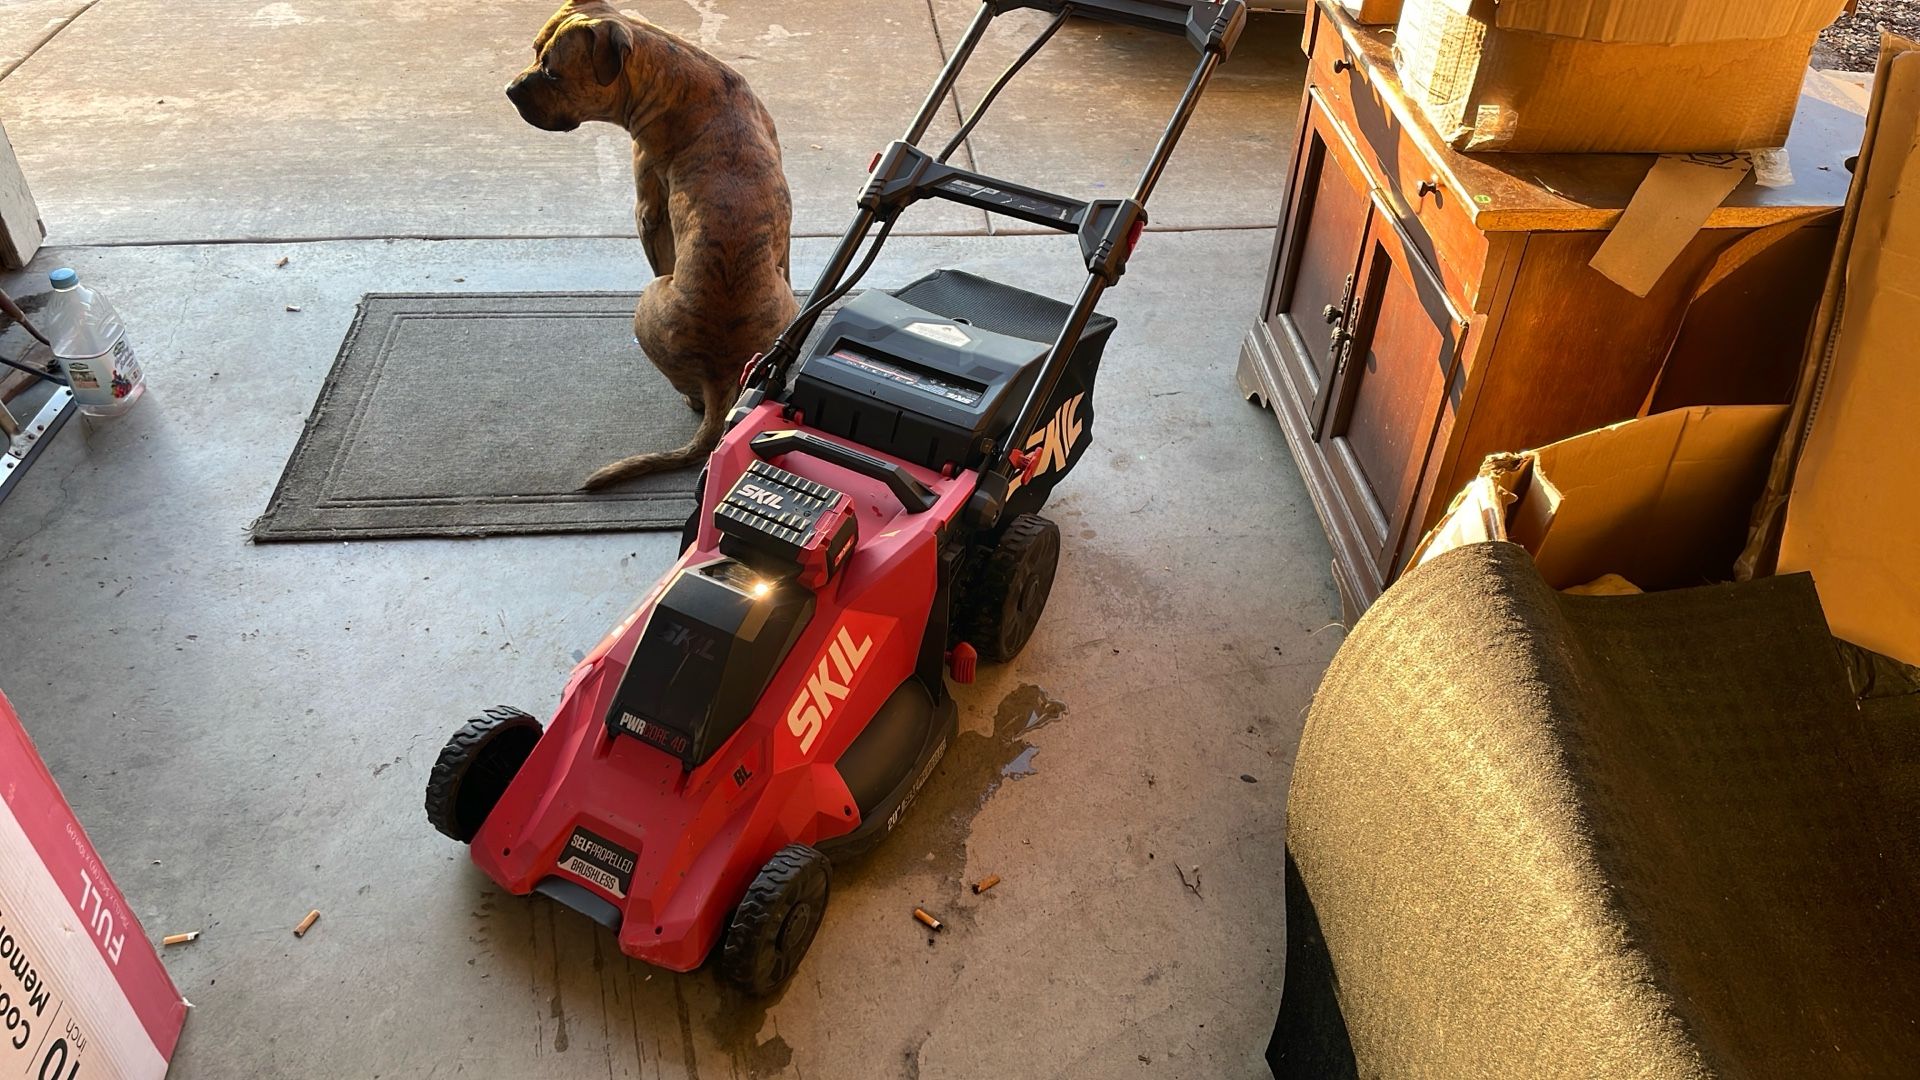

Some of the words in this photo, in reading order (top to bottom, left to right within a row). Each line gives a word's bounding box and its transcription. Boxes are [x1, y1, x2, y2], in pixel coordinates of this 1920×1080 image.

[1005, 391, 1085, 503] SKIL
[736, 484, 784, 510] SKIL
[657, 621, 715, 661] SKIL
[787, 625, 873, 756] SKIL
[619, 711, 671, 746] PWRCORE
[671, 736, 687, 753] 40
[732, 765, 752, 788] BL
[570, 834, 634, 874] SELFPROPELLED
[570, 858, 616, 890] BRUSHLESS
[80, 868, 125, 966] FULL
[65, 1017, 87, 1057] inch
